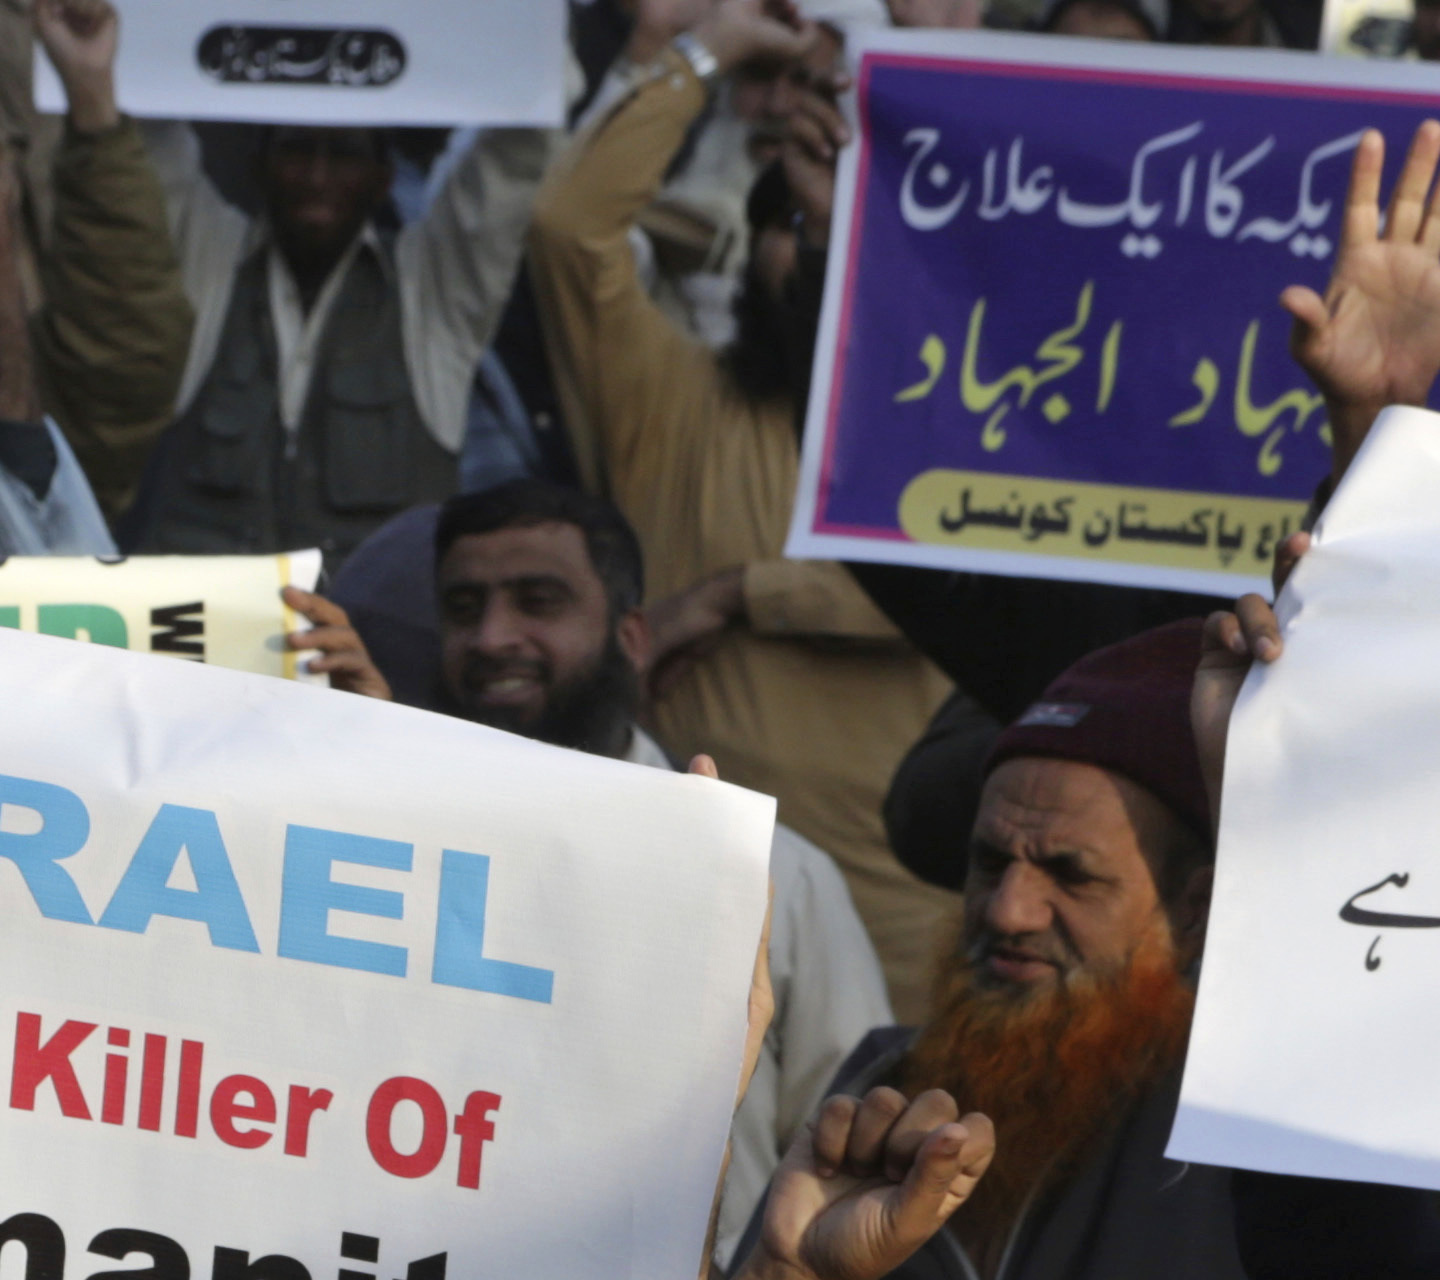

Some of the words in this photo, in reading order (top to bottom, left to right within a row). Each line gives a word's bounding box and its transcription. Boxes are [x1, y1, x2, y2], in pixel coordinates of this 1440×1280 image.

[898, 126, 1057, 232] علاج
[1056, 120, 1206, 260] ایک
[1203, 133, 1279, 240] کا
[892, 277, 1124, 453] الجہاد
[937, 486, 1075, 538] کونسل
[1082, 498, 1245, 568] پاکستان
[7, 1008, 335, 1160] Killer
[362, 1072, 504, 1192] Of
